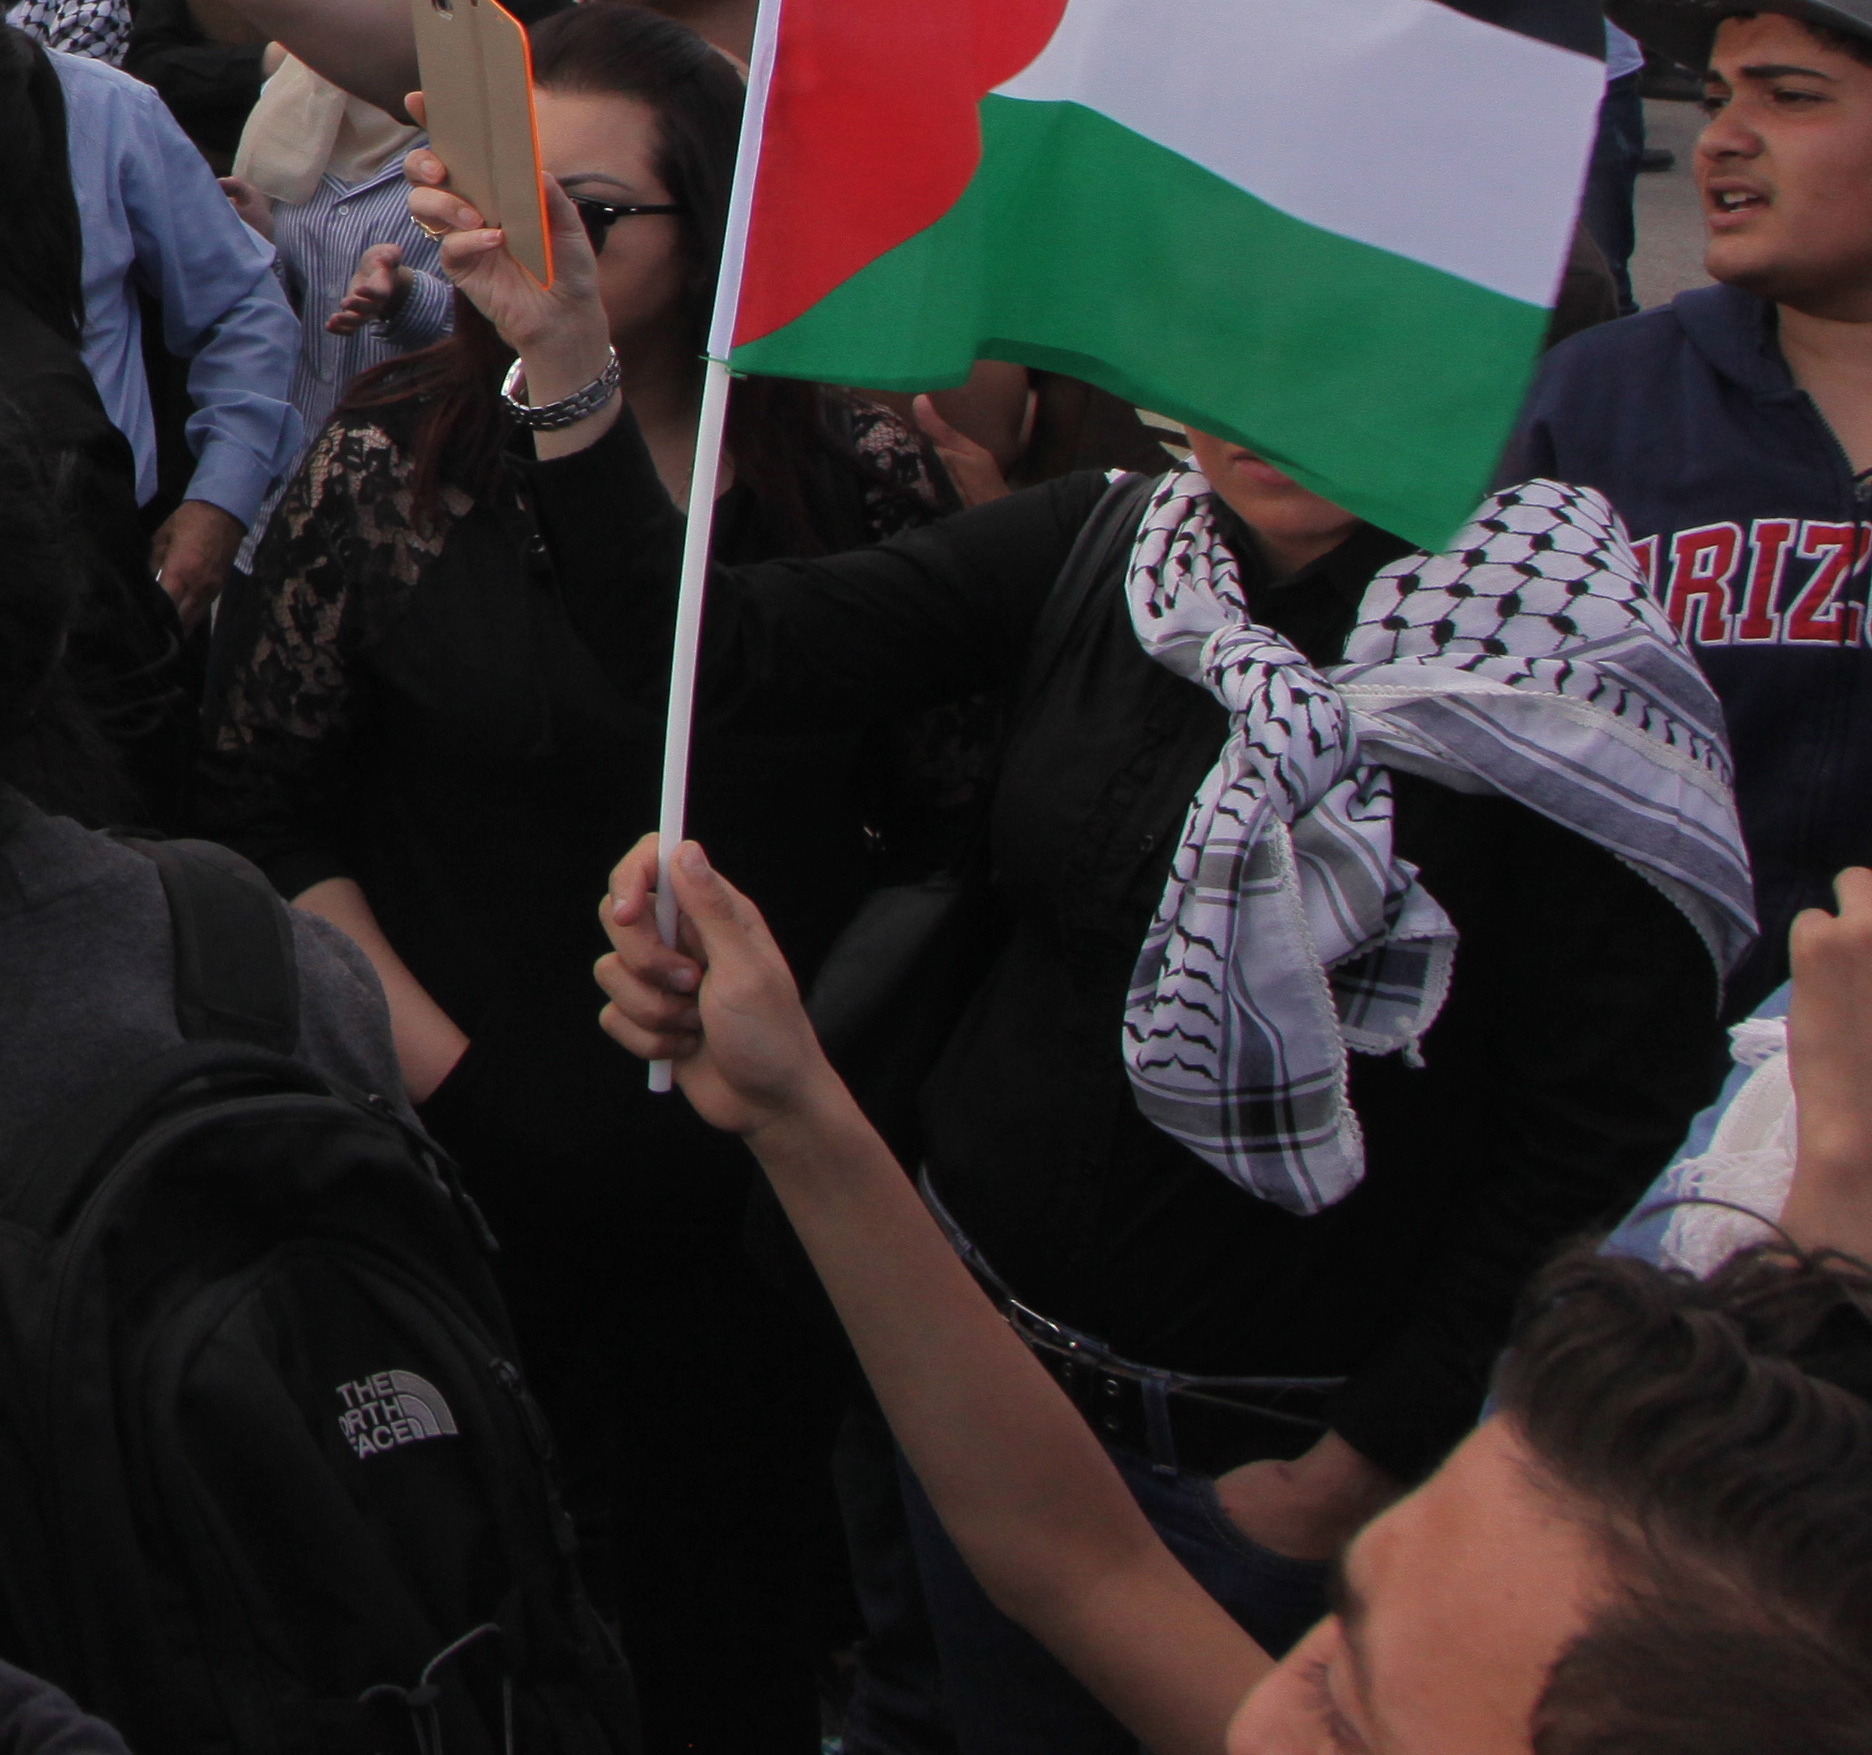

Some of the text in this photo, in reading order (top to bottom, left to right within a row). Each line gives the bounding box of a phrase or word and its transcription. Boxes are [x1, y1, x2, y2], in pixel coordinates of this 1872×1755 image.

[1630, 517, 1872, 647] RIZ
[335, 1371, 394, 1408] THE
[338, 1395, 404, 1436] ORTH
